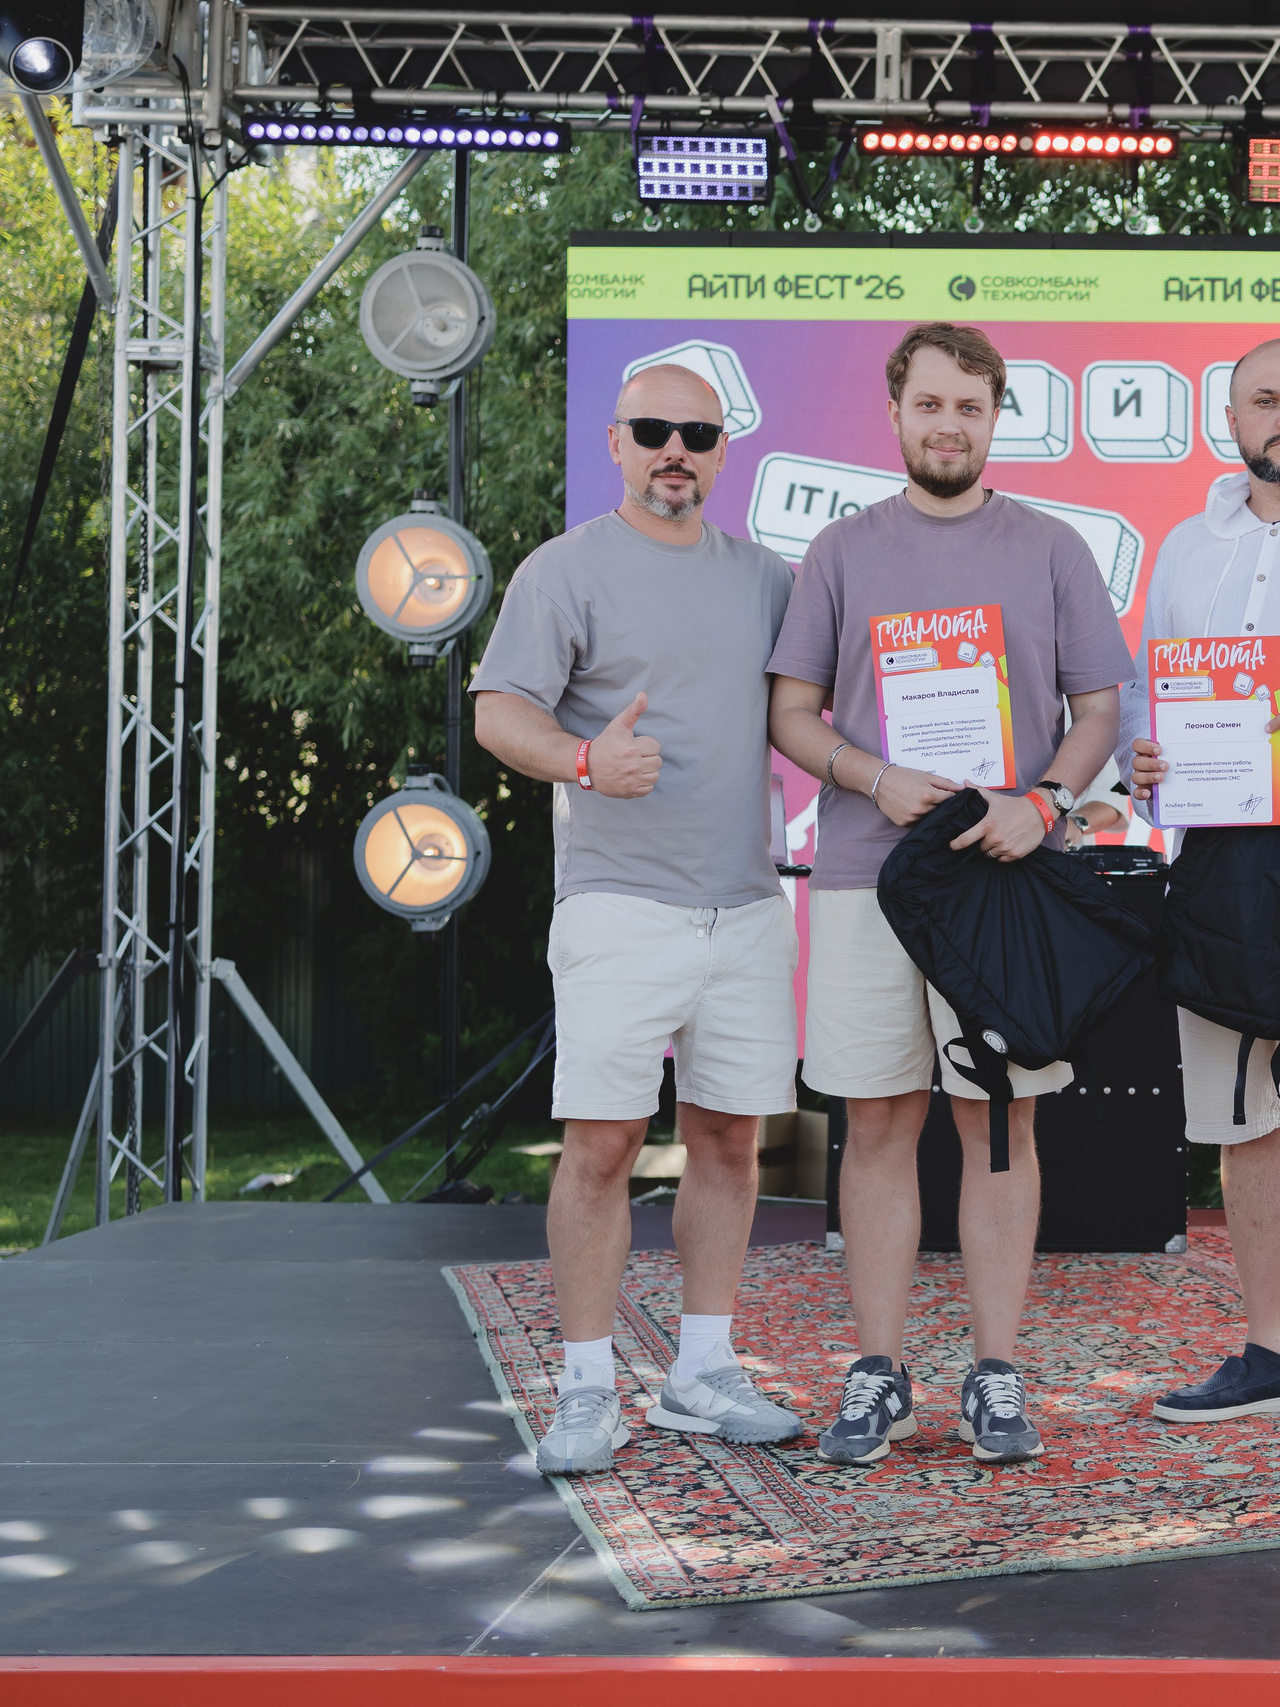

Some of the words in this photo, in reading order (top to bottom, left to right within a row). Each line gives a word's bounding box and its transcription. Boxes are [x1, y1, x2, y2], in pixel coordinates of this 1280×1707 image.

[981, 276, 1099, 288] СОВКОМБАНК
[981, 289, 1091, 301] ТЕХНОЛОГИИ
[1113, 378, 1142, 417] Й
[784, 482, 824, 515] IT
[828, 490, 868, 518] lo
[877, 608, 988, 648] ГРАМОТА
[1154, 638, 1267, 673] ГРАМОТА
[901, 691, 936, 702] Макаров
[937, 687, 980, 699] Владислав
[1184, 721, 1214, 730] Леонов
[1215, 721, 1242, 729] Семен
